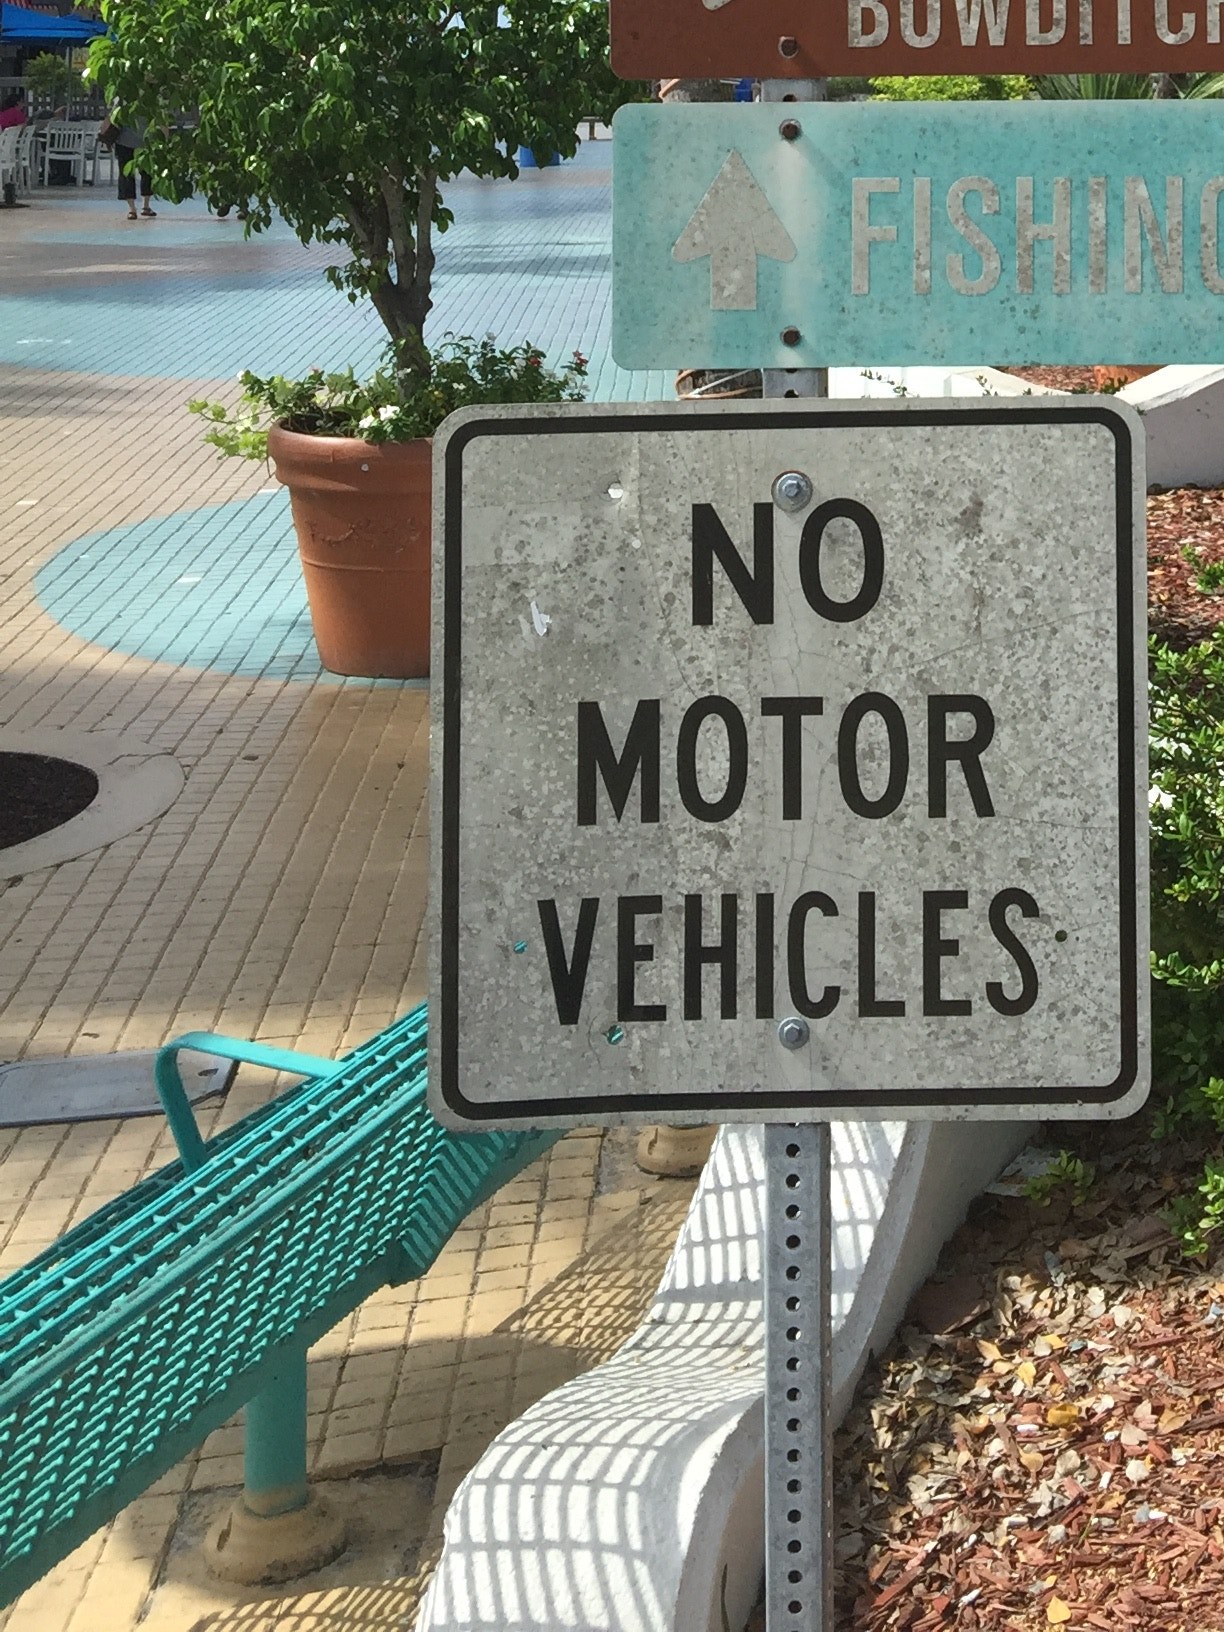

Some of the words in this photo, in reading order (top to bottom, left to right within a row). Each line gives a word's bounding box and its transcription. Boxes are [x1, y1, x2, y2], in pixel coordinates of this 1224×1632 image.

[691, 497, 885, 626] NO
[576, 691, 996, 826] MOTOR
[537, 887, 1041, 1026] VEHICLES
